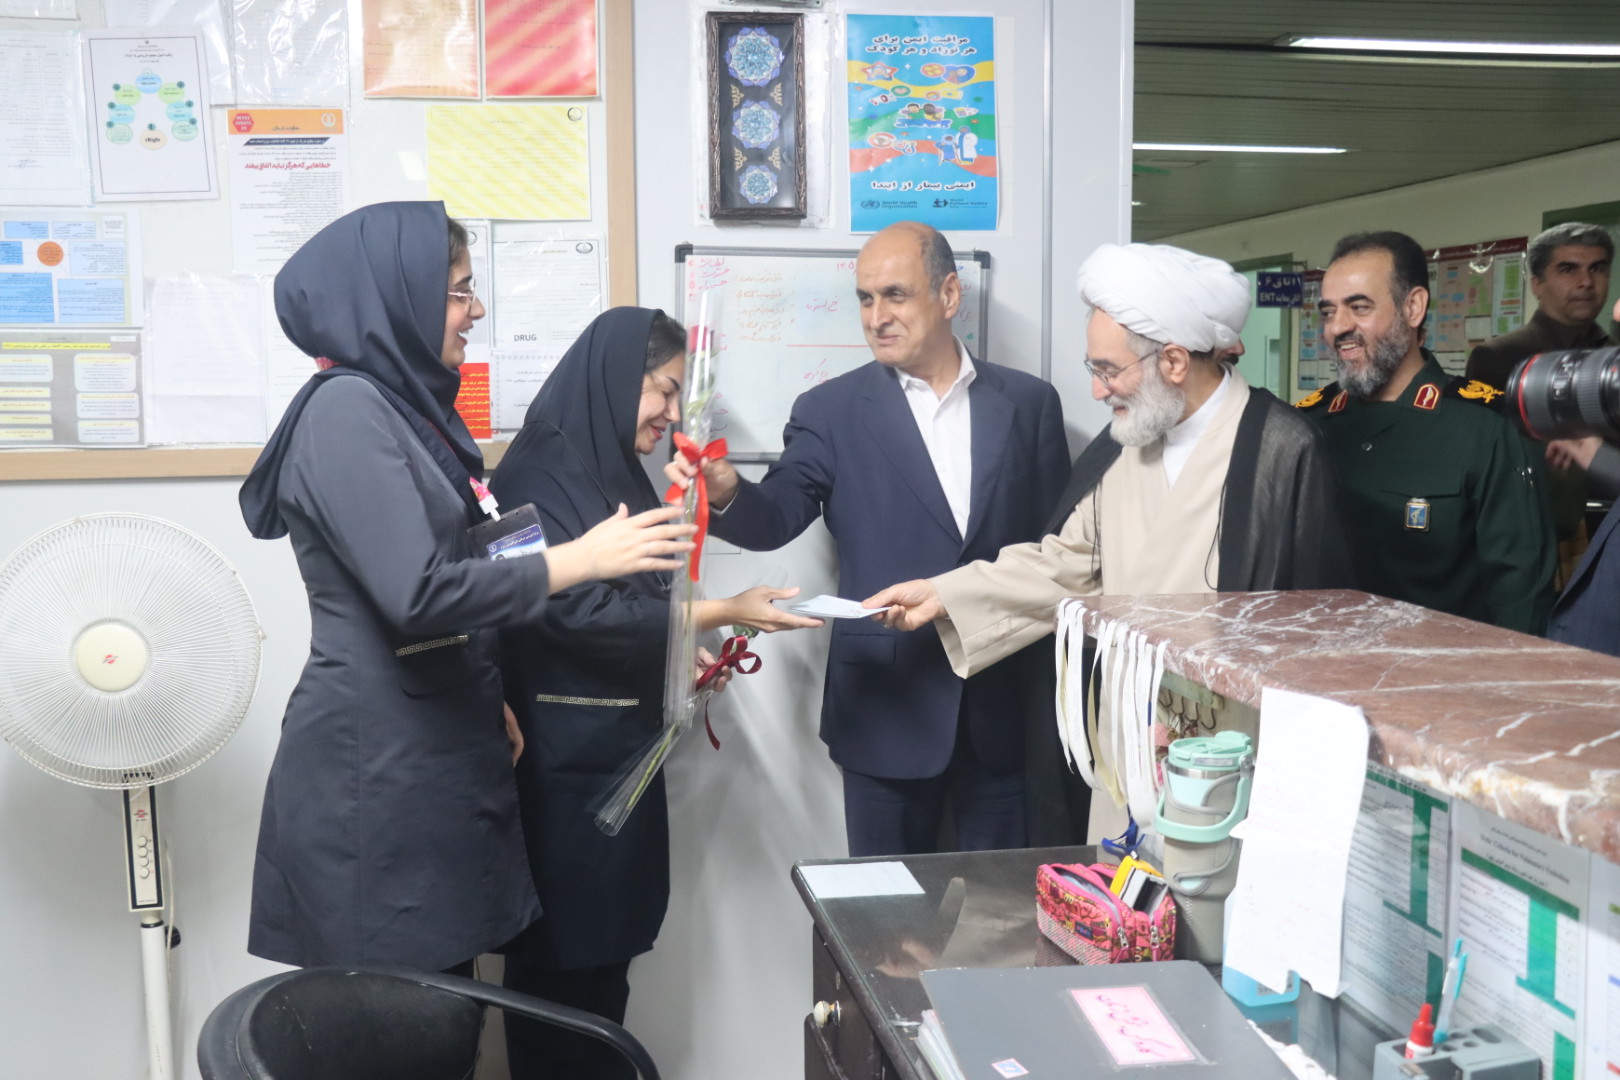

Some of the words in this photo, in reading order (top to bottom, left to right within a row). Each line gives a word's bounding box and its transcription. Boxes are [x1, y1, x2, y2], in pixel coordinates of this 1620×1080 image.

[873, 34, 899, 44] برای
[903, 34, 929, 45] ایمن
[932, 34, 970, 45] مراقبت
[866, 44, 899, 55] کودک
[902, 46, 917, 56] هر
[919, 48, 928, 56] و
[930, 46, 959, 56] نوزاد
[961, 46, 977, 56] هر
[872, 181, 896, 189] ابتدا
[901, 182, 912, 191] از
[915, 181, 941, 191] بیمار
[945, 181, 975, 191] ایمنی
[1272, 276, 1296, 288] اتاق
[1260, 292, 1276, 302] ENT
[513, 334, 537, 342] DRUG
